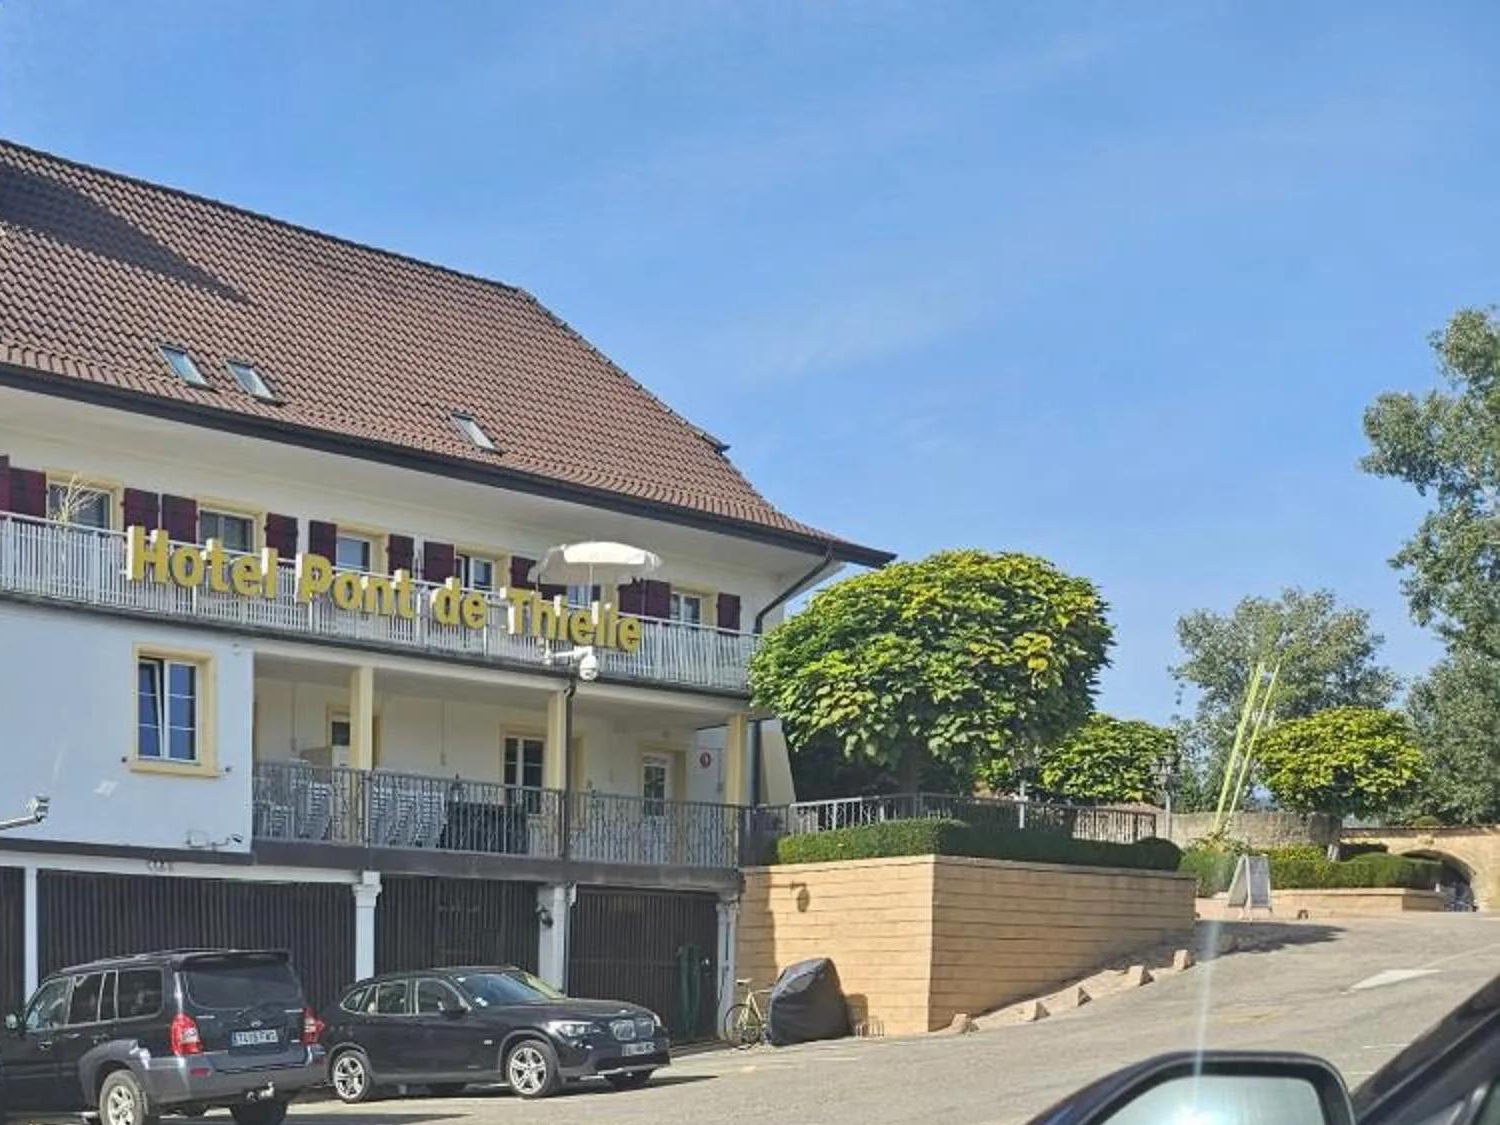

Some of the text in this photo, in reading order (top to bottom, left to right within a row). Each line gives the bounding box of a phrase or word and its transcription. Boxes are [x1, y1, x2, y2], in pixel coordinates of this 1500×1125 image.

[127, 524, 642, 654] Hotel Pont de Thielle
